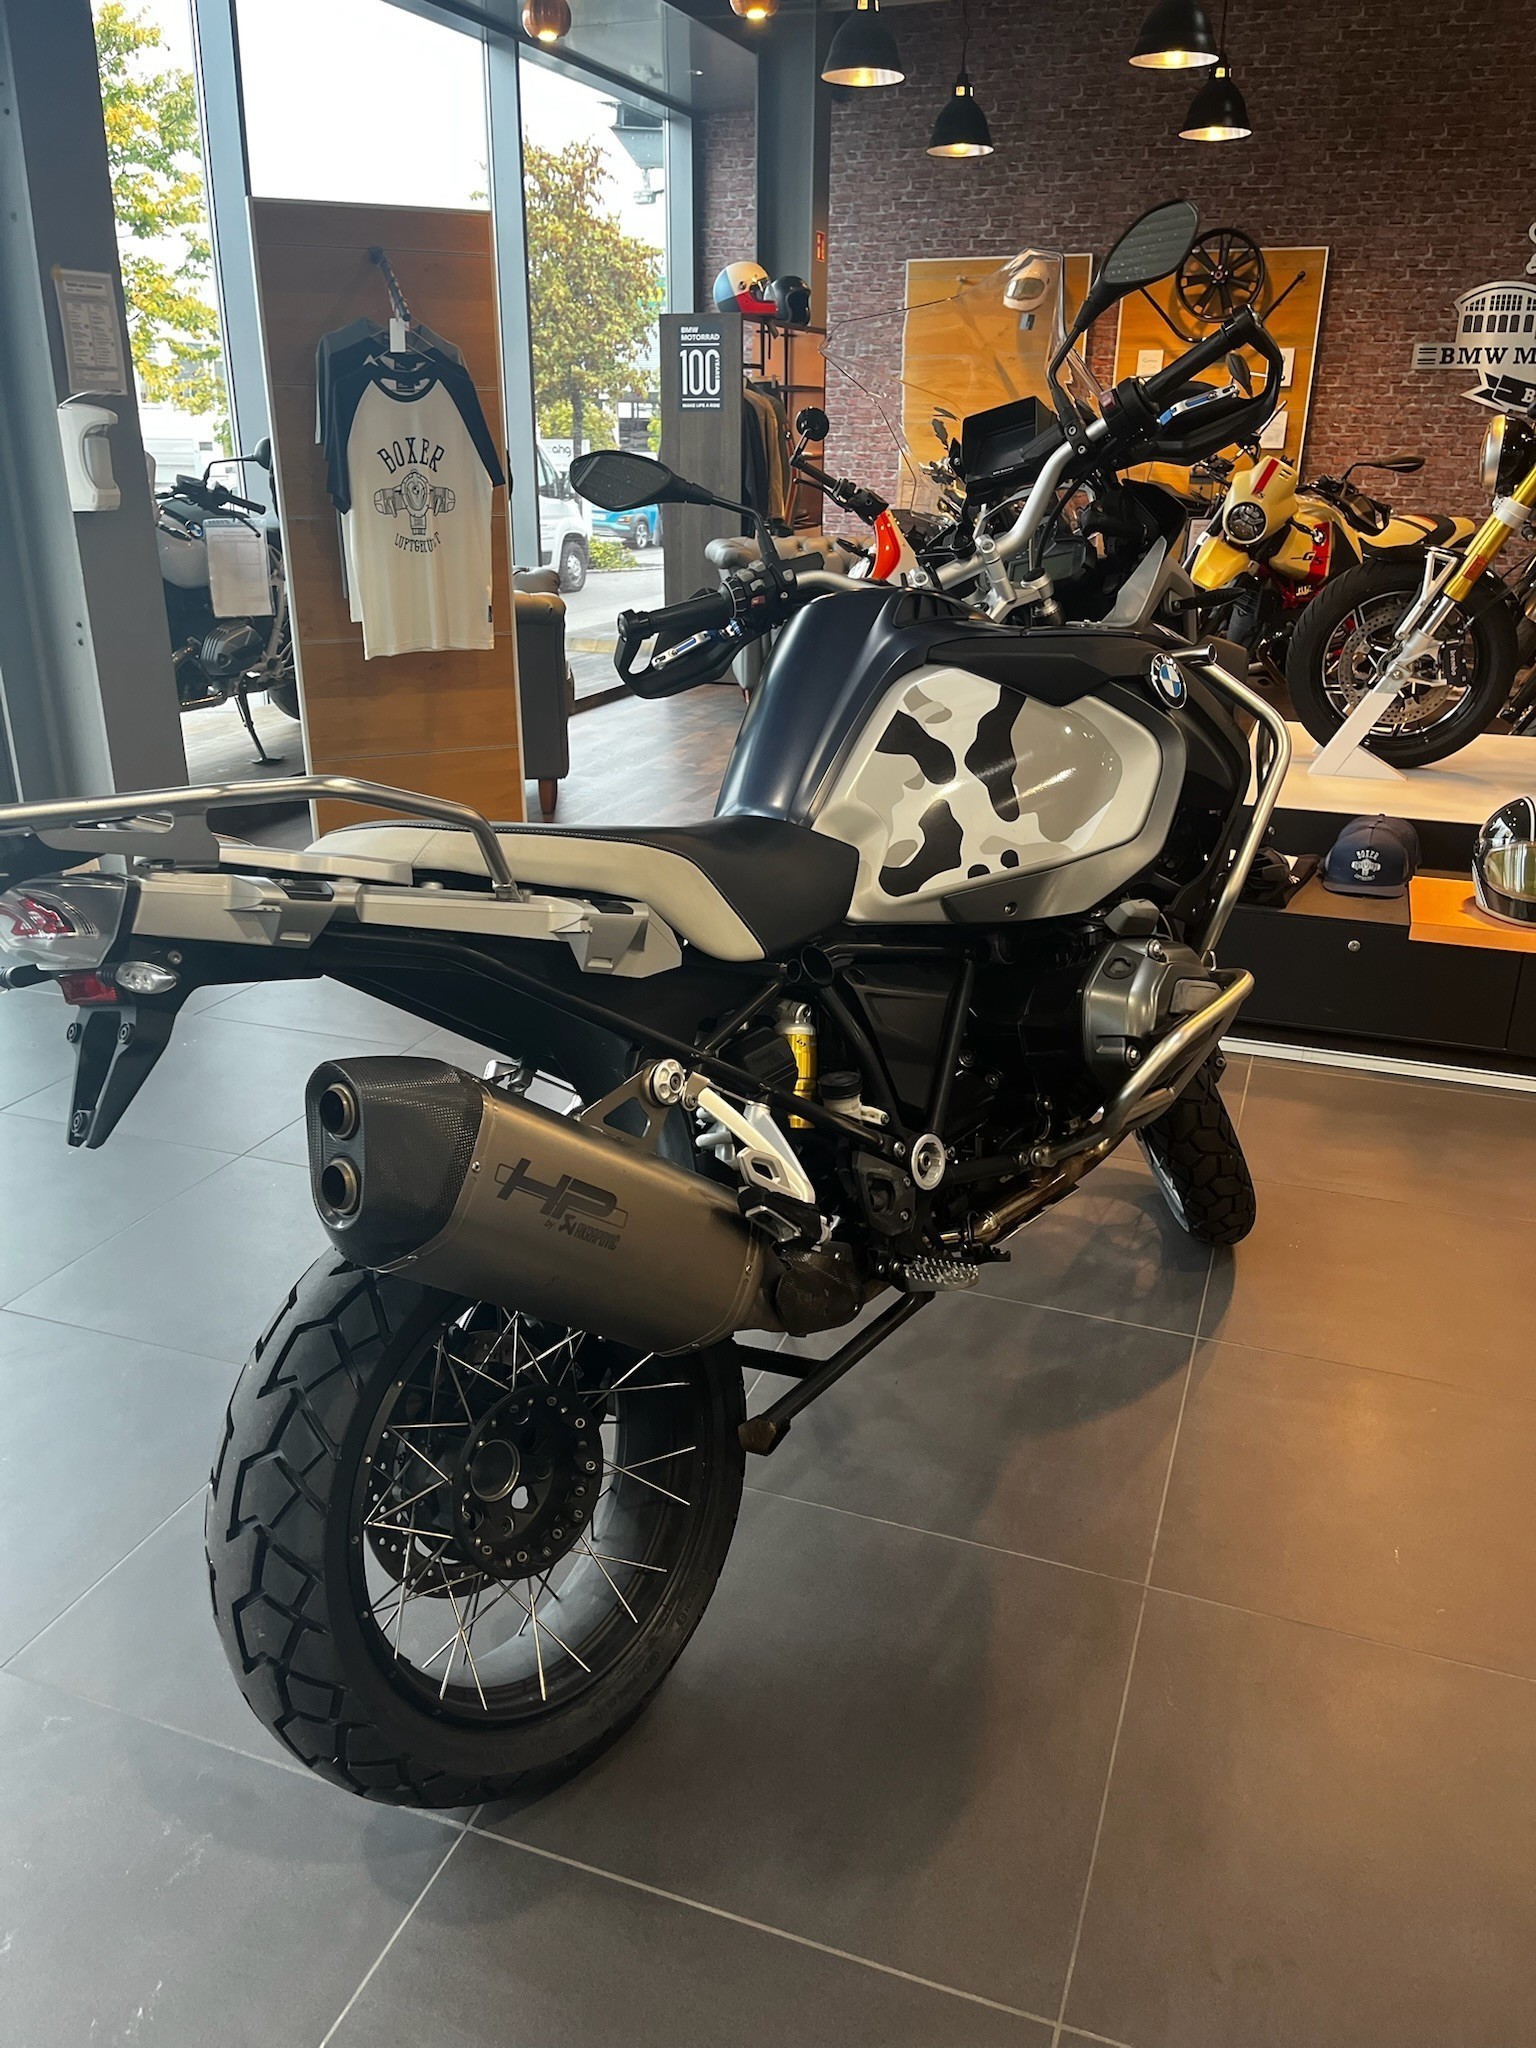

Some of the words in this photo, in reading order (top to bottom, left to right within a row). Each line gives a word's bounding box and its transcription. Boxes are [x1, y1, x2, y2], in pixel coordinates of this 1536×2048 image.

[680, 326, 699, 334] BMW
[680, 333, 721, 341] MOTORRAD
[1439, 347, 1508, 365] BMW
[679, 349, 721, 396] 100
[376, 437, 445, 474] BOXER
[496, 1157, 618, 1220] HP
